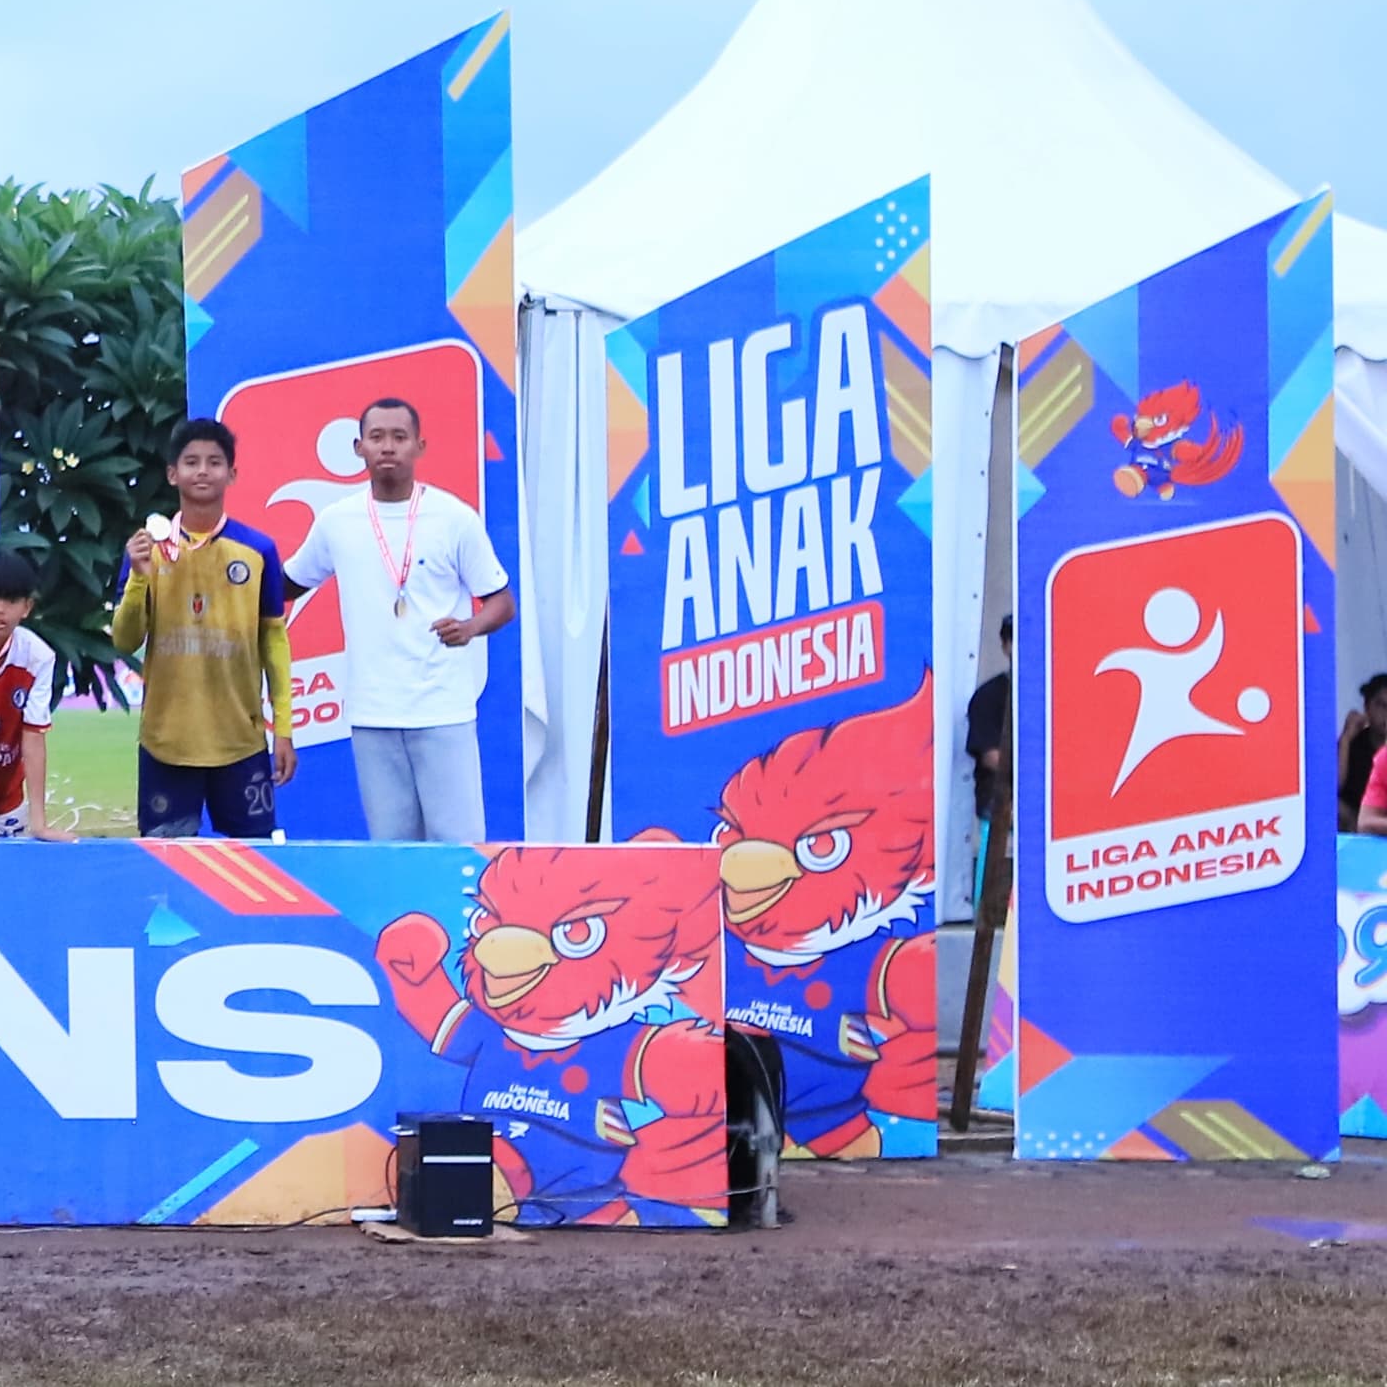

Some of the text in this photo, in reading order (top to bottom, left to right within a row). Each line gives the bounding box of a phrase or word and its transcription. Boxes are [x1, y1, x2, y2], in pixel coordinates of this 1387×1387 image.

[657, 304, 882, 518] LIGA
[661, 467, 883, 651] ANAK
[668, 612, 876, 728] INDONESIA
[244, 781, 274, 816] 20
[1066, 815, 1282, 873] LIGA ANAK
[1066, 847, 1282, 904] INDONESIA
[725, 1008, 813, 1037] INDONESIA
[482, 1091, 569, 1121] INDONESIA
